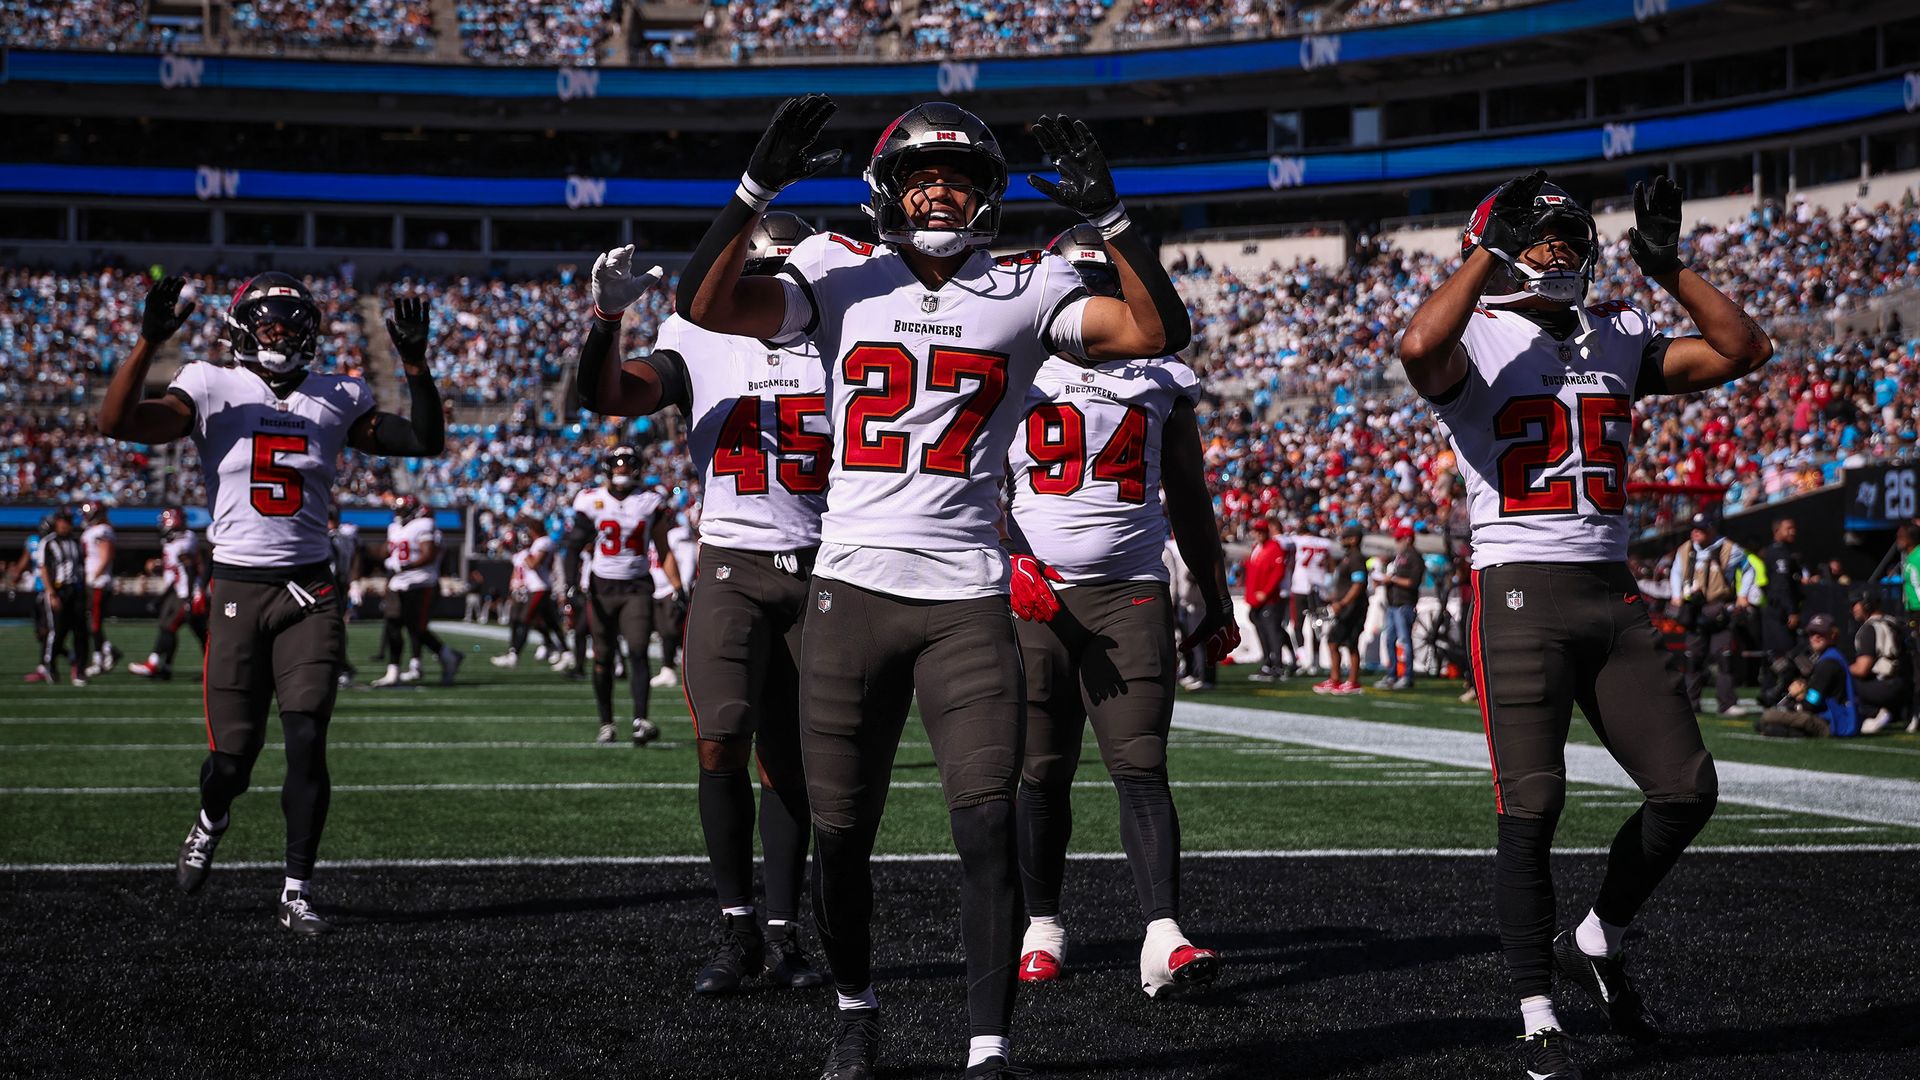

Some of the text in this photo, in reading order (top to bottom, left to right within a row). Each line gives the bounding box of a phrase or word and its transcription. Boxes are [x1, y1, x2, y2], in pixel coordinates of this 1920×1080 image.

[1300, 34, 1341, 71] ON
[160, 56, 204, 89] ON
[557, 66, 600, 101] ON
[937, 60, 978, 95] ON
[1903, 72, 1920, 113] O
[1602, 122, 1636, 161] ON
[1268, 155, 1306, 192] ON
[565, 175, 607, 210] ON
[894, 320, 963, 338] BUCCANEERS
[748, 378, 800, 391] BUCCANEERS
[1065, 385, 1118, 401] BUCCANEERS
[1541, 373, 1599, 388] BUCCANEERS
[842, 341, 1010, 479] 27
[713, 393, 832, 495] 45
[1025, 401, 1148, 502] 94
[1492, 393, 1632, 518] 25
[250, 431, 308, 517] 5
[1884, 469, 1915, 519] 26
[600, 520, 645, 557] 34
